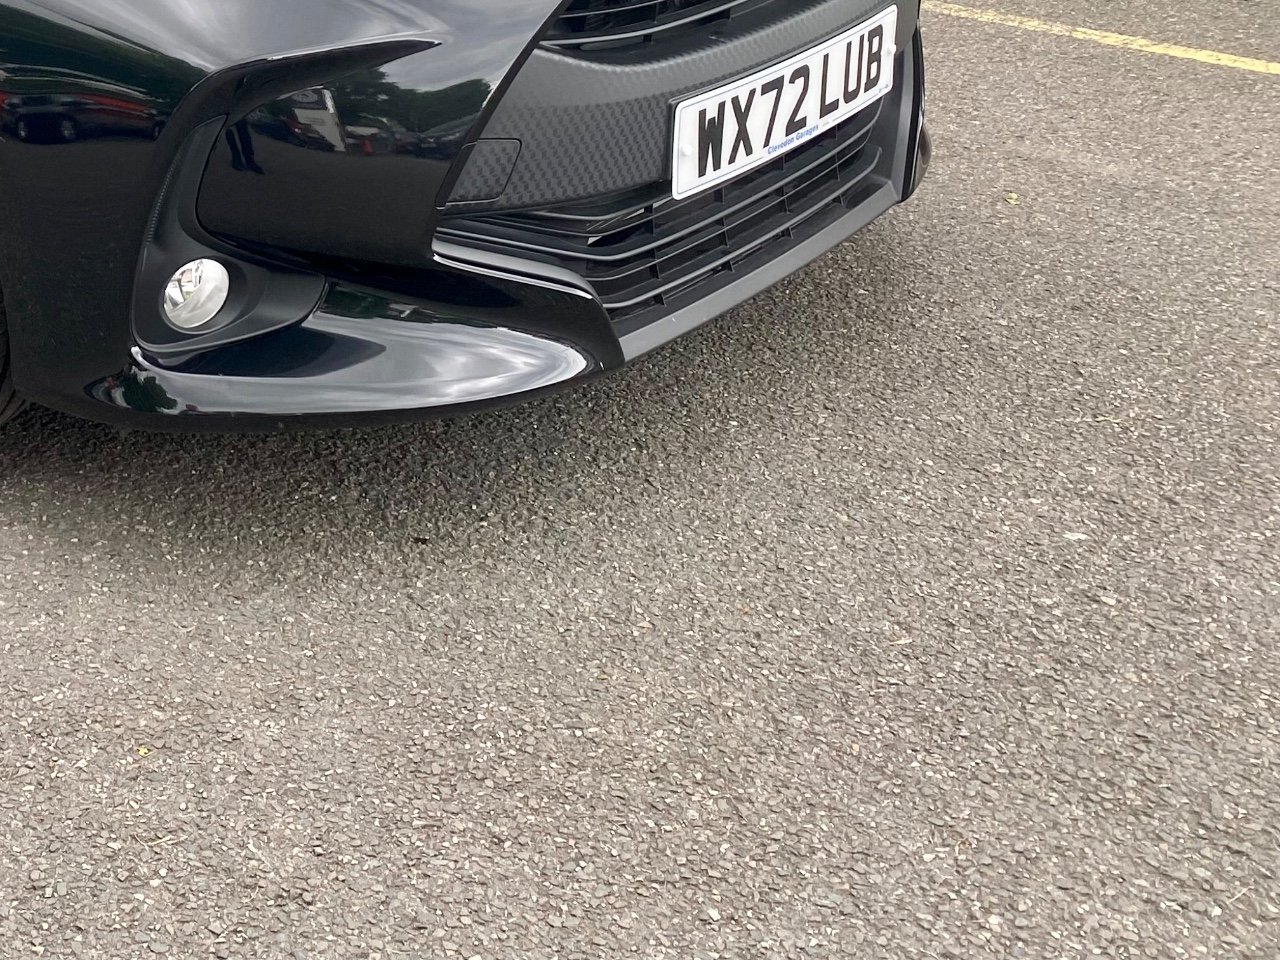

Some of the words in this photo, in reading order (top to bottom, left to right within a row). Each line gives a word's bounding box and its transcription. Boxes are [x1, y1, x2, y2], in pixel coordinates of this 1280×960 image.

[698, 63, 810, 179] WX72
[819, 23, 884, 120] LUB
[767, 136, 795, 155] Clevedon
